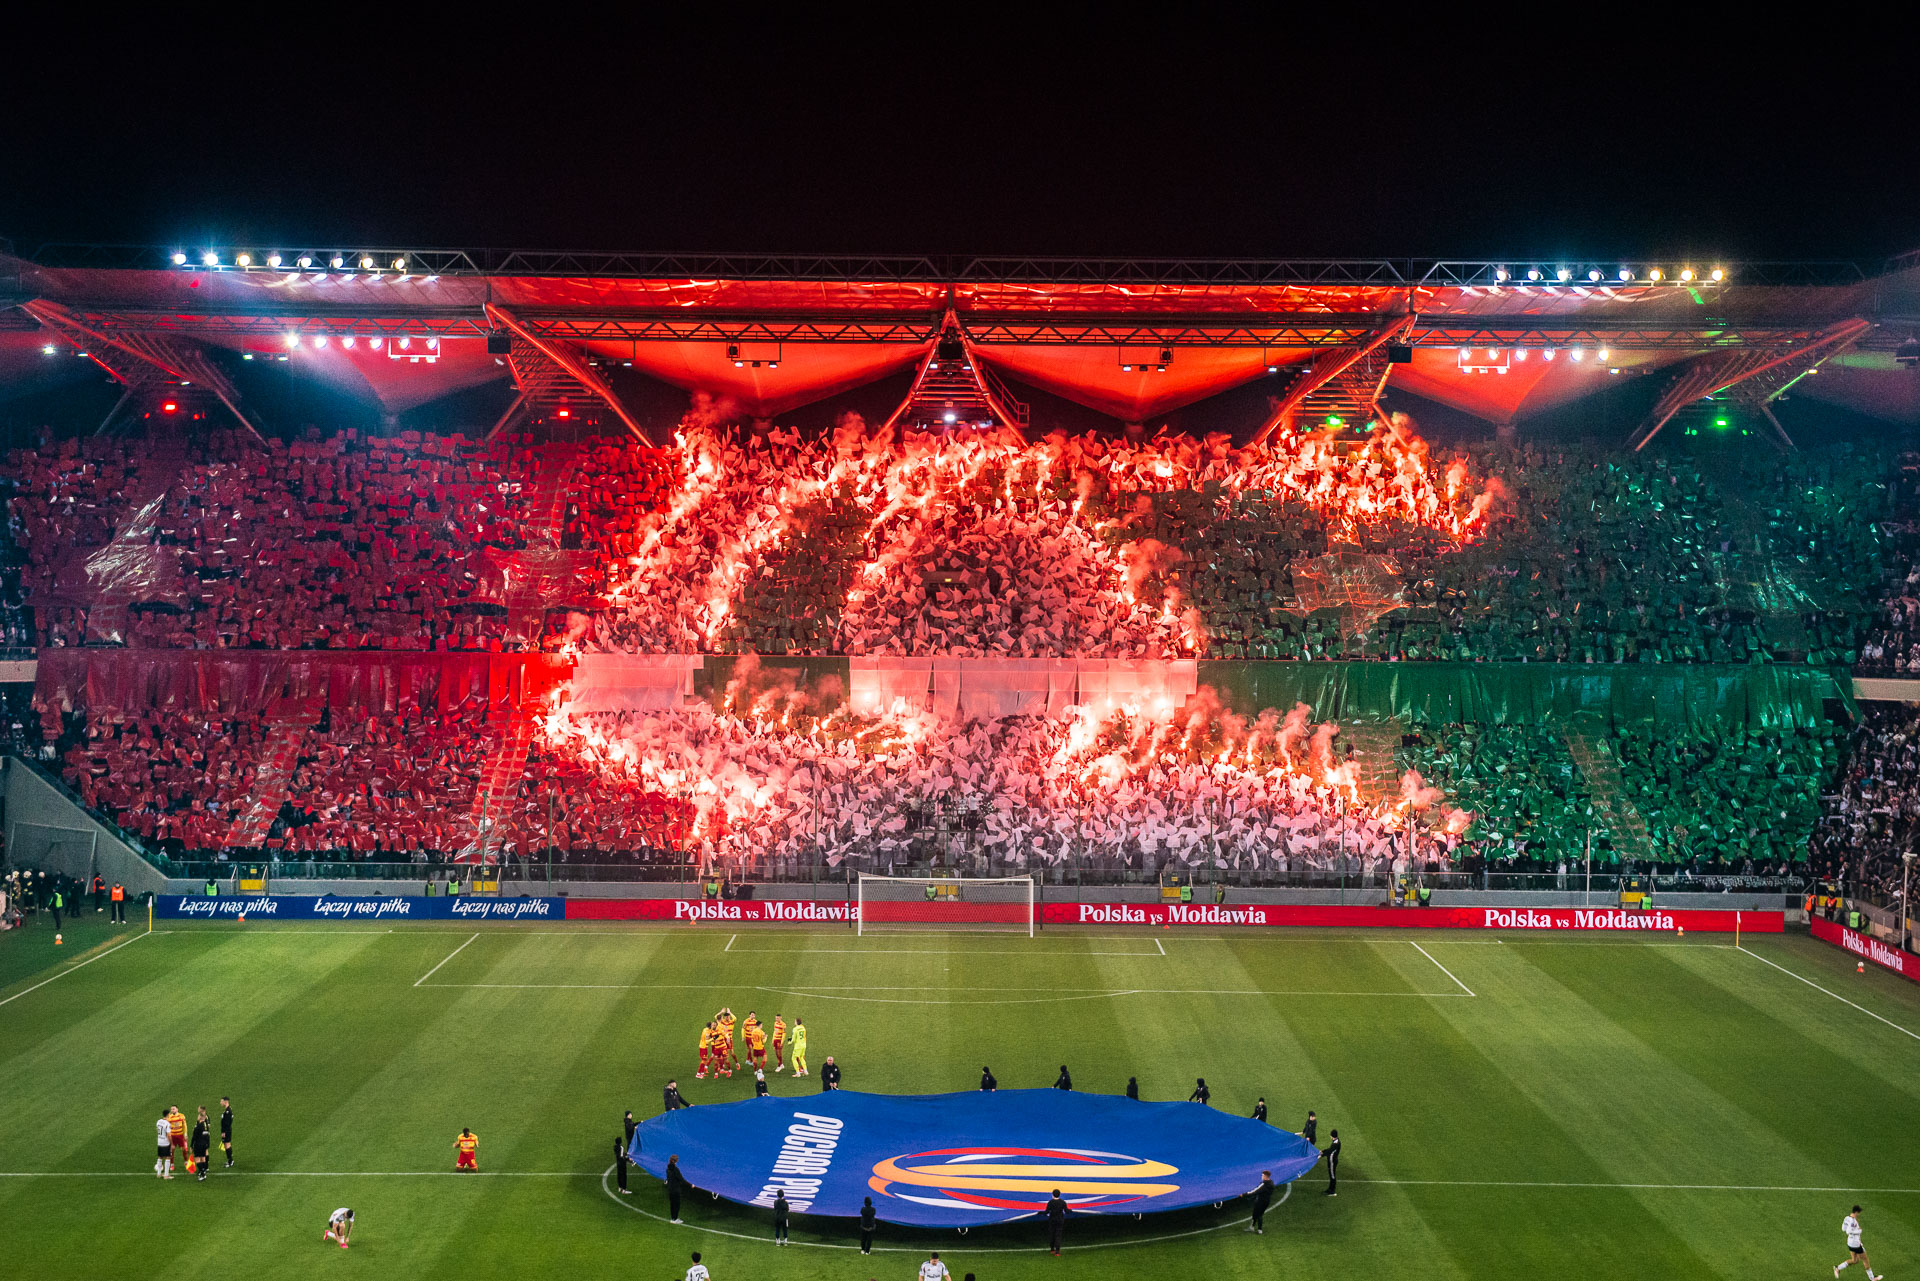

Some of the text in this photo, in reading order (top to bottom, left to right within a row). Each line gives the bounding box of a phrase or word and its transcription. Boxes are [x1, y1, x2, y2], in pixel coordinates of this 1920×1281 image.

[178, 897, 277, 917] Łączy nas piłka
[313, 898, 411, 918] Łączy nas piłka
[451, 898, 549, 919] Łączy nas piłka
[674, 901, 860, 920] Polska vs Mołdawia
[1079, 904, 1267, 924] Polska vs Mołdawia
[1484, 909, 1674, 929] Polska vs Mołdawia
[1842, 928, 1864, 955] Polska
[772, 1112, 844, 1175] PUCHAR
